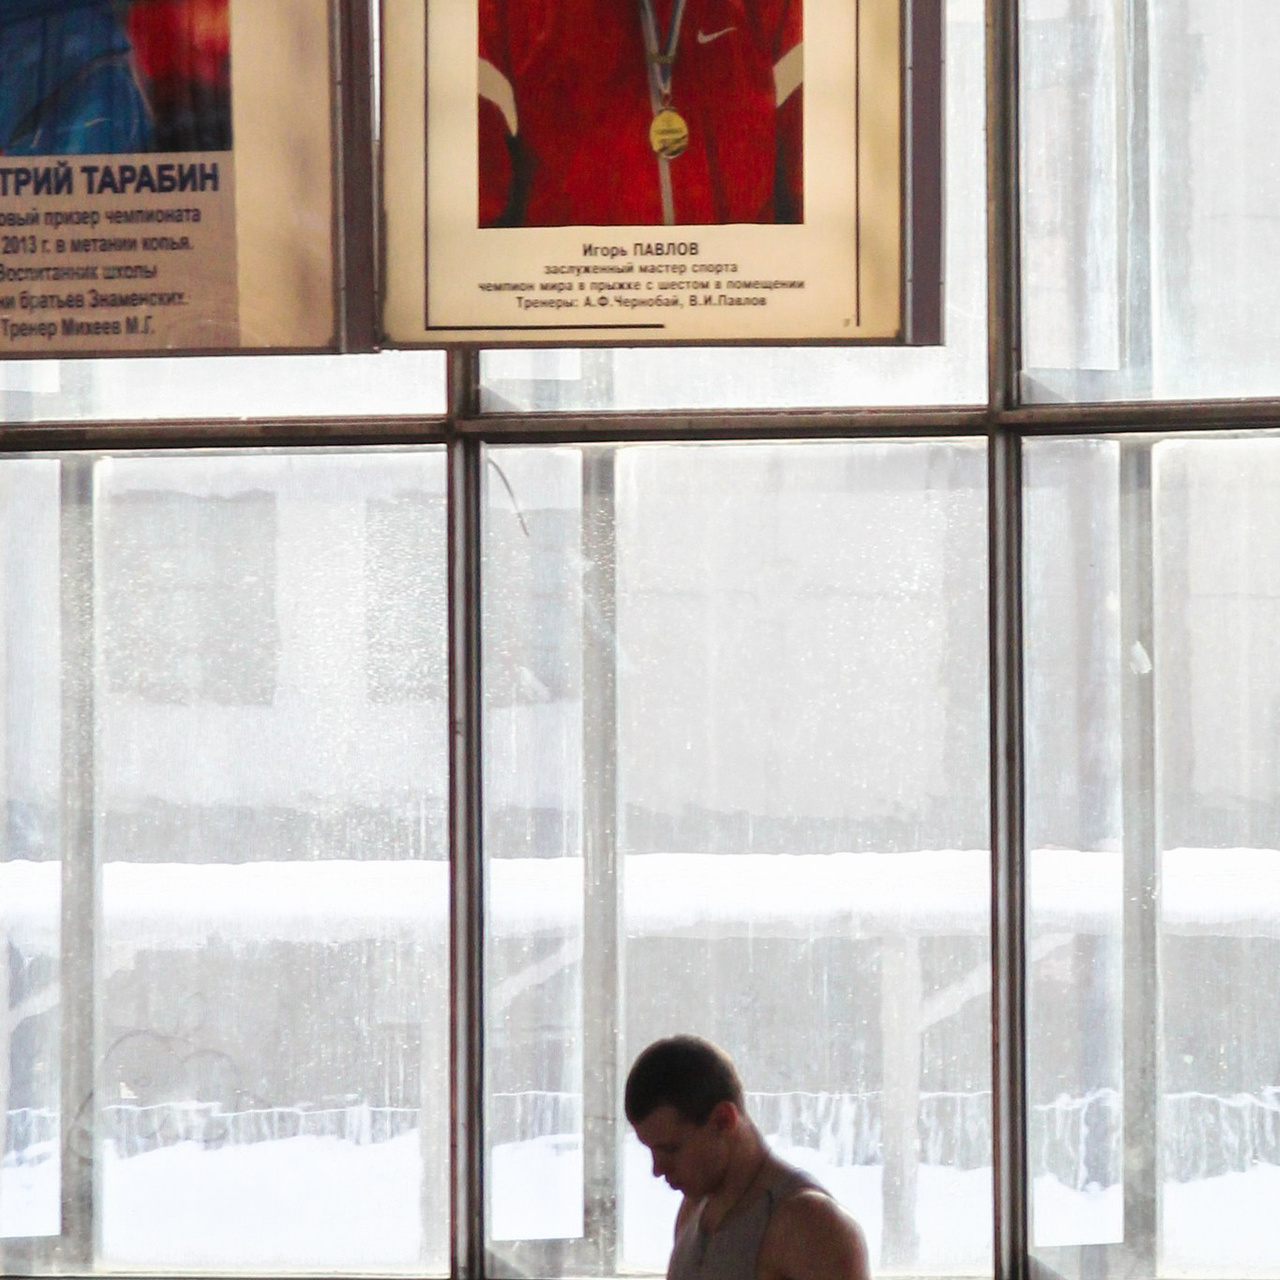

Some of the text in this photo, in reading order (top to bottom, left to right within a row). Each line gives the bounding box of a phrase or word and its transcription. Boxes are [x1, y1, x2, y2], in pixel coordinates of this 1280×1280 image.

[80, 163, 219, 194] ТАРАБИН
[44, 210, 99, 229] призер
[105, 209, 201, 224] чемпионата
[2, 235, 37, 254] 2013
[56, 239, 66, 253] в
[70, 238, 137, 253] метании
[582, 242, 700, 259] Игорь ПАВЛОВ
[103, 265, 157, 279] школы
[544, 262, 739, 276] заслуженный мастер спорта
[478, 279, 805, 293] чемпион мира в прыжке с шестом в помещении
[20, 290, 84, 314] братьев
[516, 296, 579, 310] Тренеры:
[689, 294, 767, 307] В.И.Павлов
[1, 318, 57, 341] Тренер
[61, 317, 122, 335] Михеев
